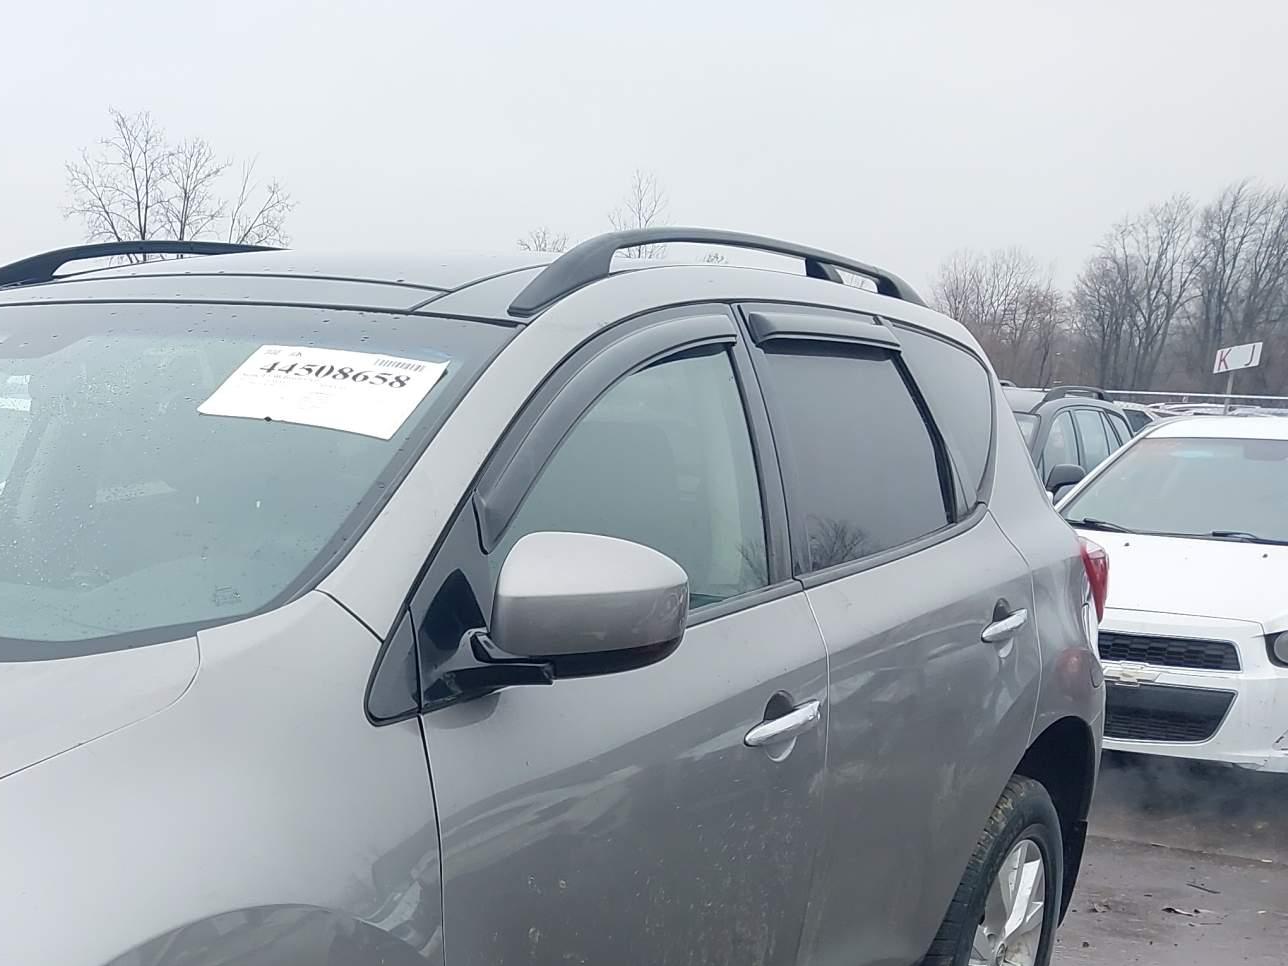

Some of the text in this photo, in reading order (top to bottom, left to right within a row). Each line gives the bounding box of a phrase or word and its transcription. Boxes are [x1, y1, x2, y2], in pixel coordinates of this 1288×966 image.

[1217, 344, 1256, 371] K J
[259, 360, 411, 389] 44508658
